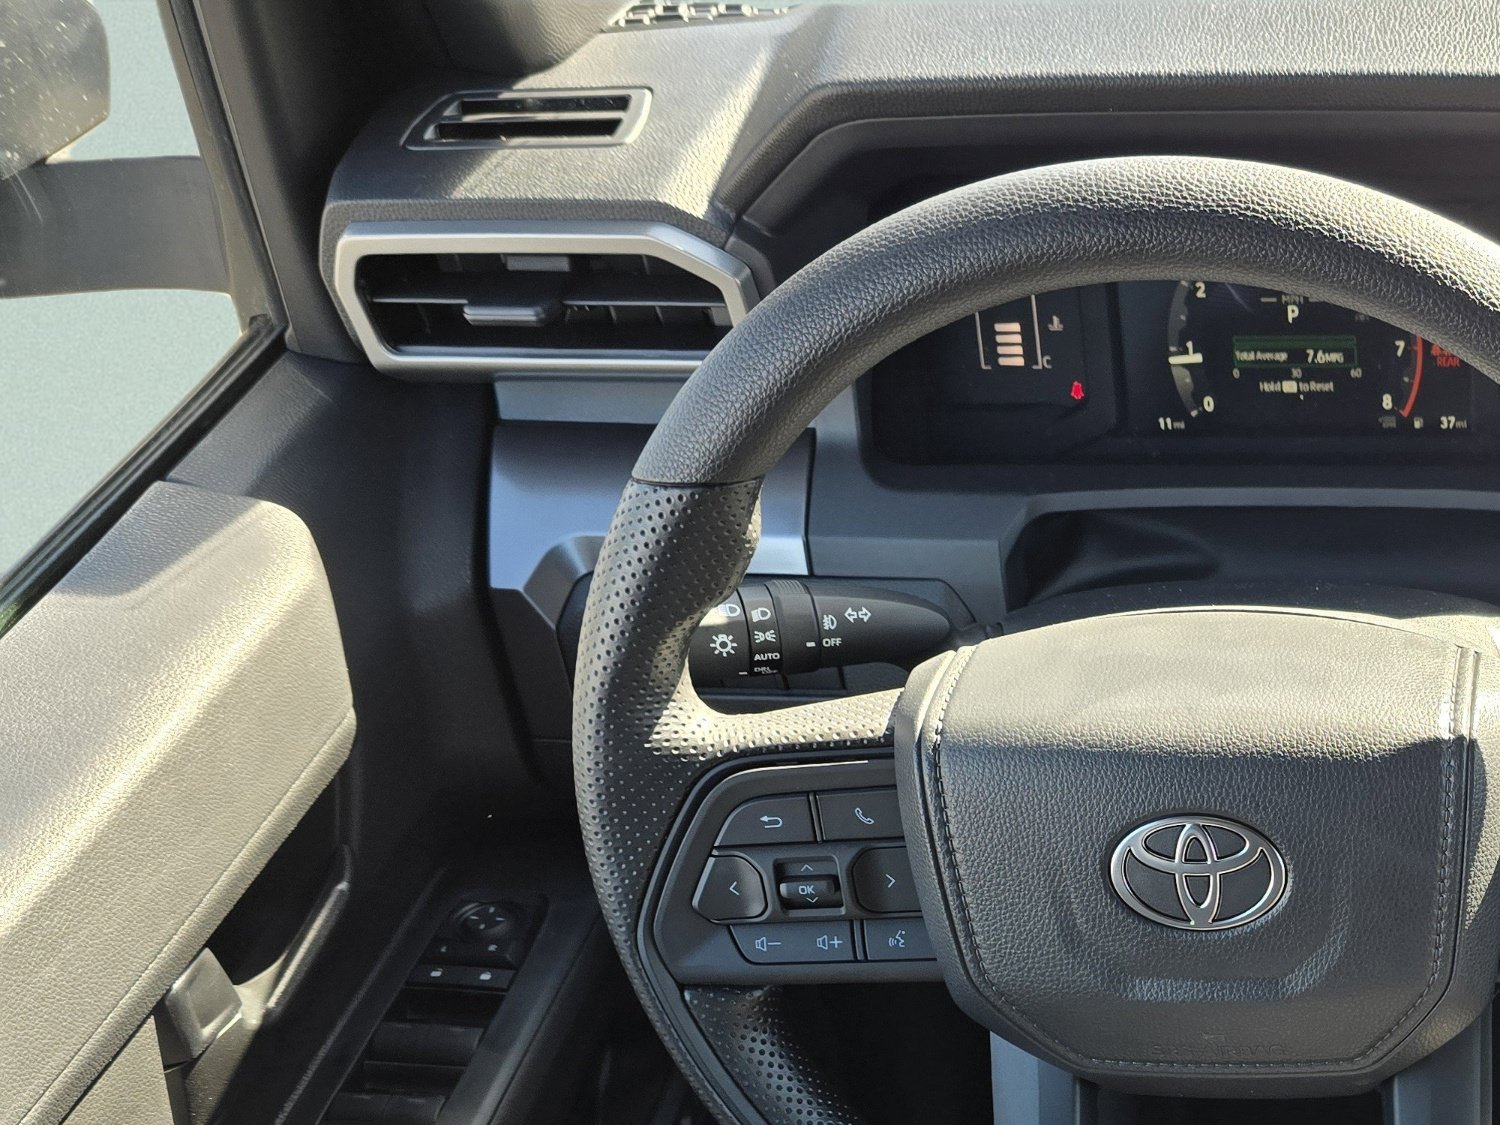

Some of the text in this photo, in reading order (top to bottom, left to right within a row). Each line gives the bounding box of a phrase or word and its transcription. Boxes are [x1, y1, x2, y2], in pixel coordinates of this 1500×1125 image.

[1195, 281, 1207, 299] 2
[1287, 304, 1300, 324] P
[1395, 340, 1405, 358] 7
[1043, 355, 1052, 369] C
[1350, 367, 1363, 378] 60
[1259, 381, 1335, 393] Hold to Reset
[1203, 395, 1215, 413] 0
[1382, 393, 1393, 411] 8
[822, 637, 842, 648] OFF
[754, 652, 781, 661] AUTO
[798, 885, 815, 895] OK
